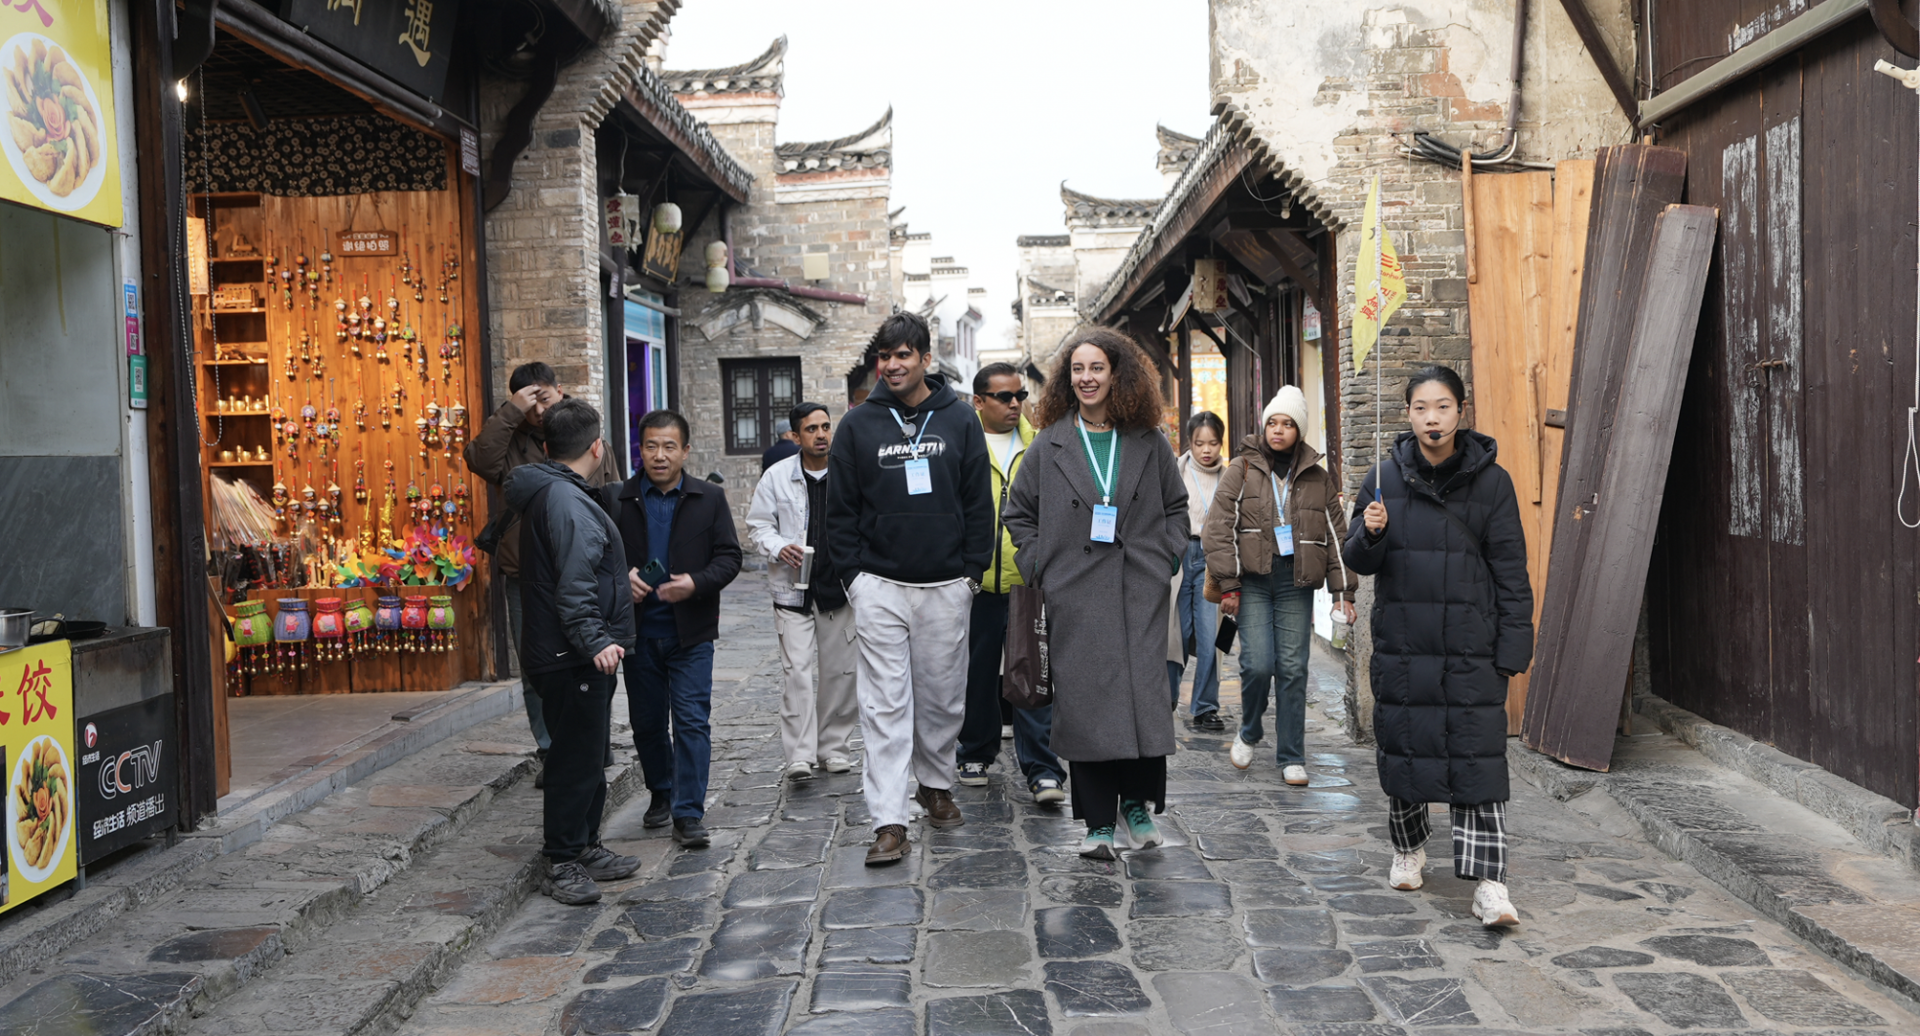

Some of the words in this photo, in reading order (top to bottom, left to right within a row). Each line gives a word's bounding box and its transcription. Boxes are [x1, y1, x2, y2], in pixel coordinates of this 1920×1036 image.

[98, 739, 162, 800] CCTV
[126, 793, 165, 828] 频道播出
